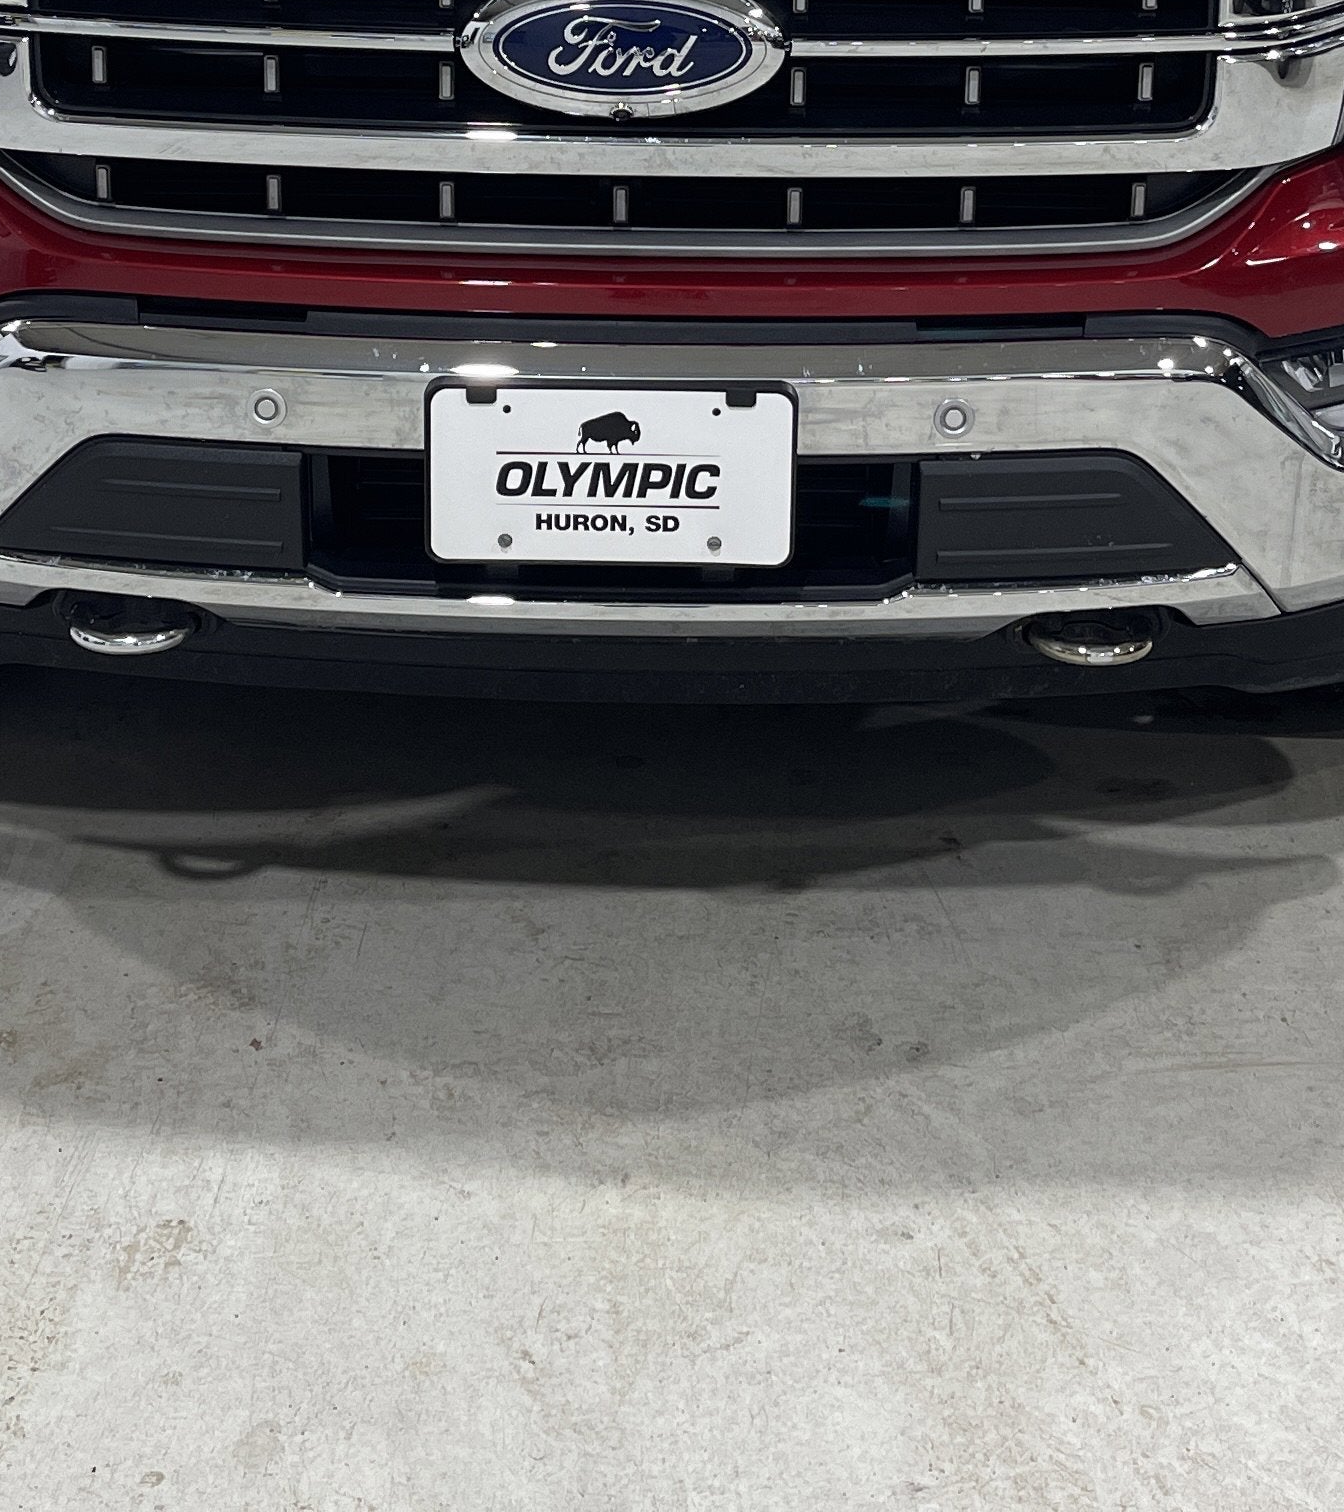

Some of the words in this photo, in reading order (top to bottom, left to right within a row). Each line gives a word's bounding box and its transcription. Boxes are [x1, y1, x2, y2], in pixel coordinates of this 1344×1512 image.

[546, 15, 699, 78] Ford
[496, 461, 720, 499] OLYMPIC
[536, 514, 634, 535] HURON,
[645, 515, 679, 532] SD
